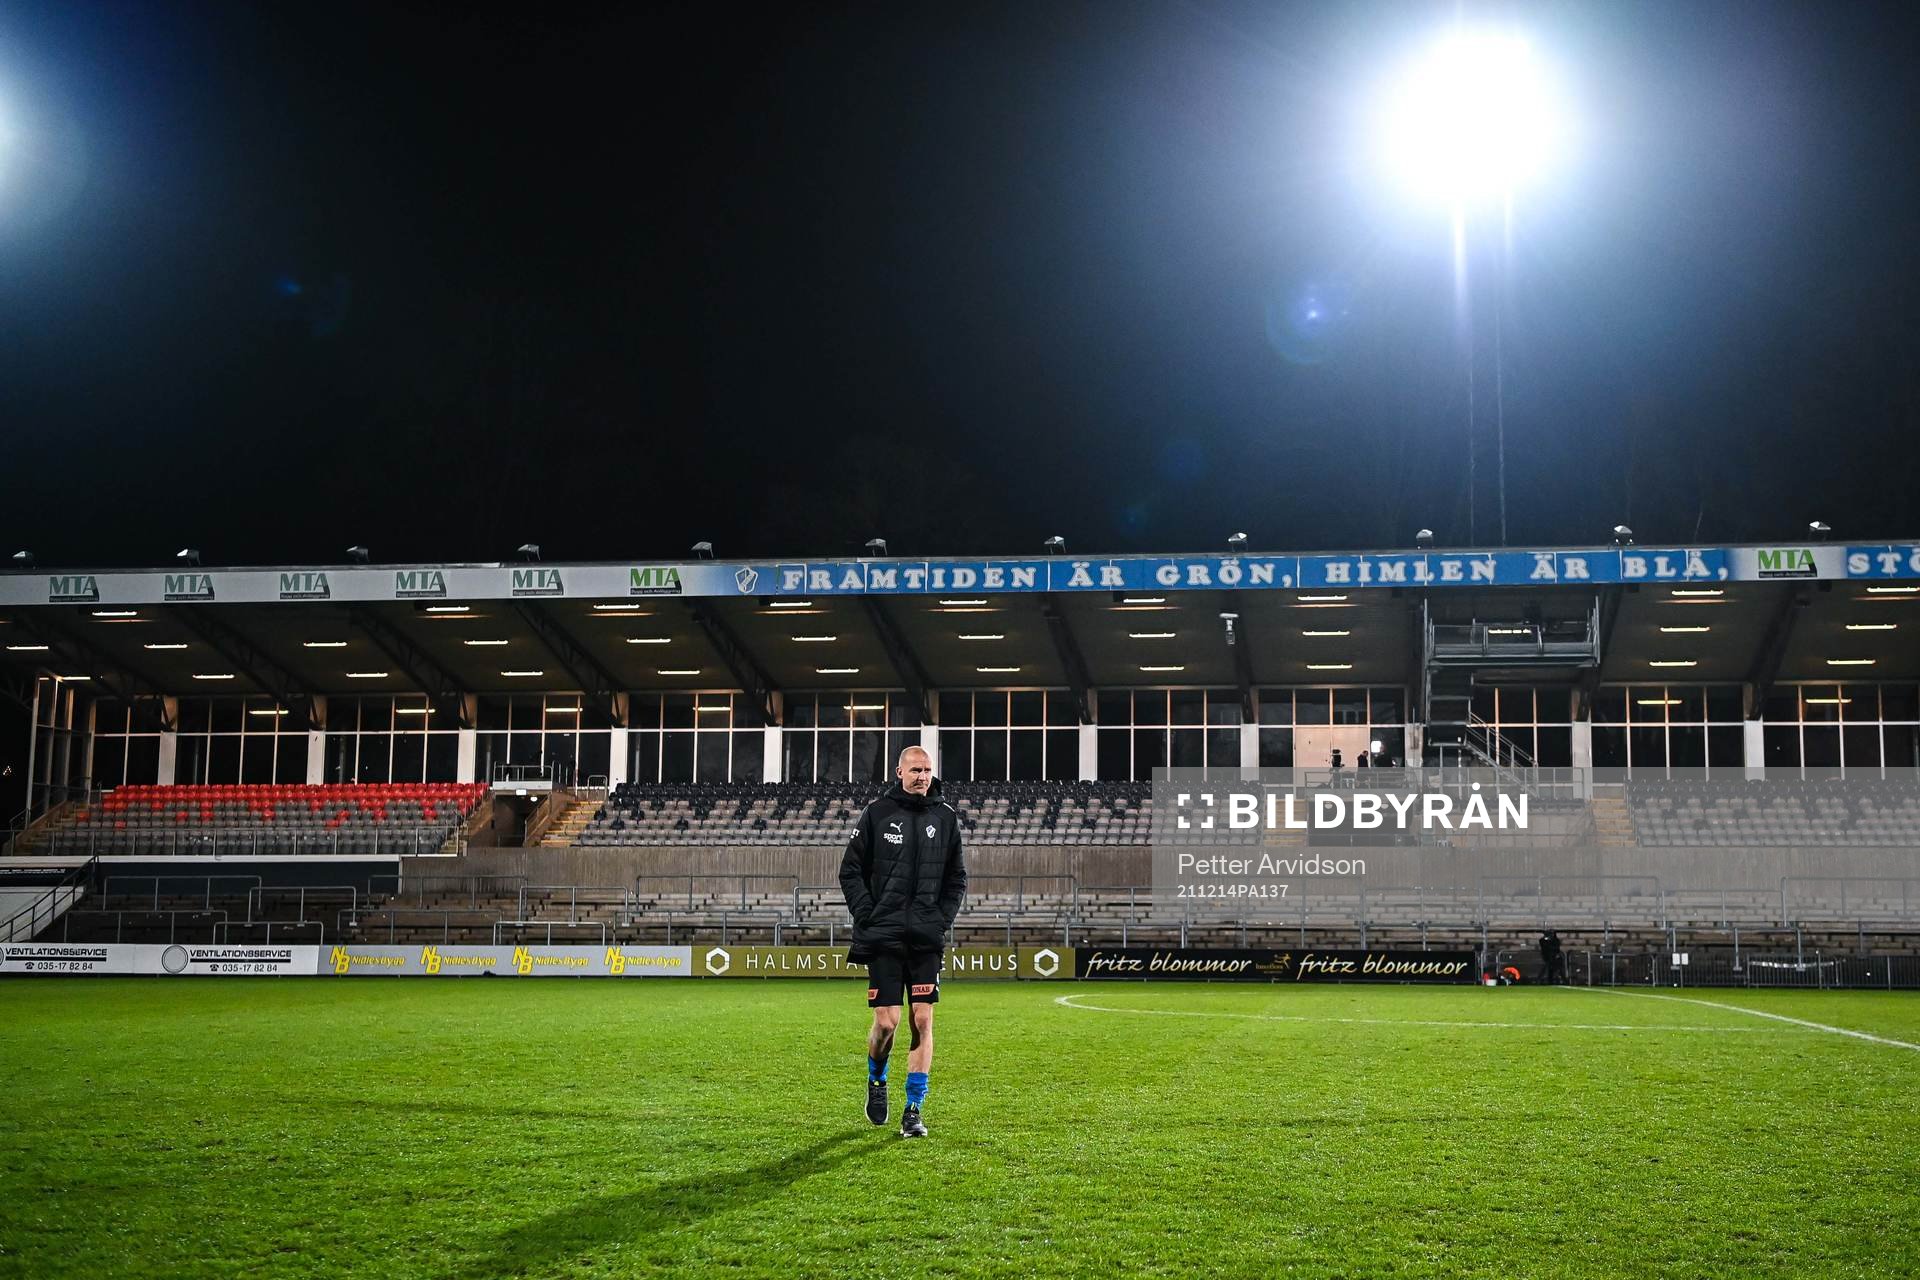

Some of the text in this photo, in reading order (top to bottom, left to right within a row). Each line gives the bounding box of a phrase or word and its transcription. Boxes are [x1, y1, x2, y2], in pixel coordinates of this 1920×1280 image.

[1758, 549, 1815, 570] MTA
[513, 569, 562, 588] MTA
[631, 568, 680, 586] MTA
[782, 550, 1728, 590] FRAMTIDEN ÄR GRÖN, HIMLEN ÄR BLÅ,
[49, 576, 97, 593] MTA
[164, 575, 213, 593] MTA
[280, 573, 328, 591] MTA
[396, 571, 446, 590] MTA
[5, 947, 107, 956] VENTILATIONSSERVICE
[1085, 952, 1252, 978] fritz blommor
[1297, 953, 1467, 980] fritz blommor
